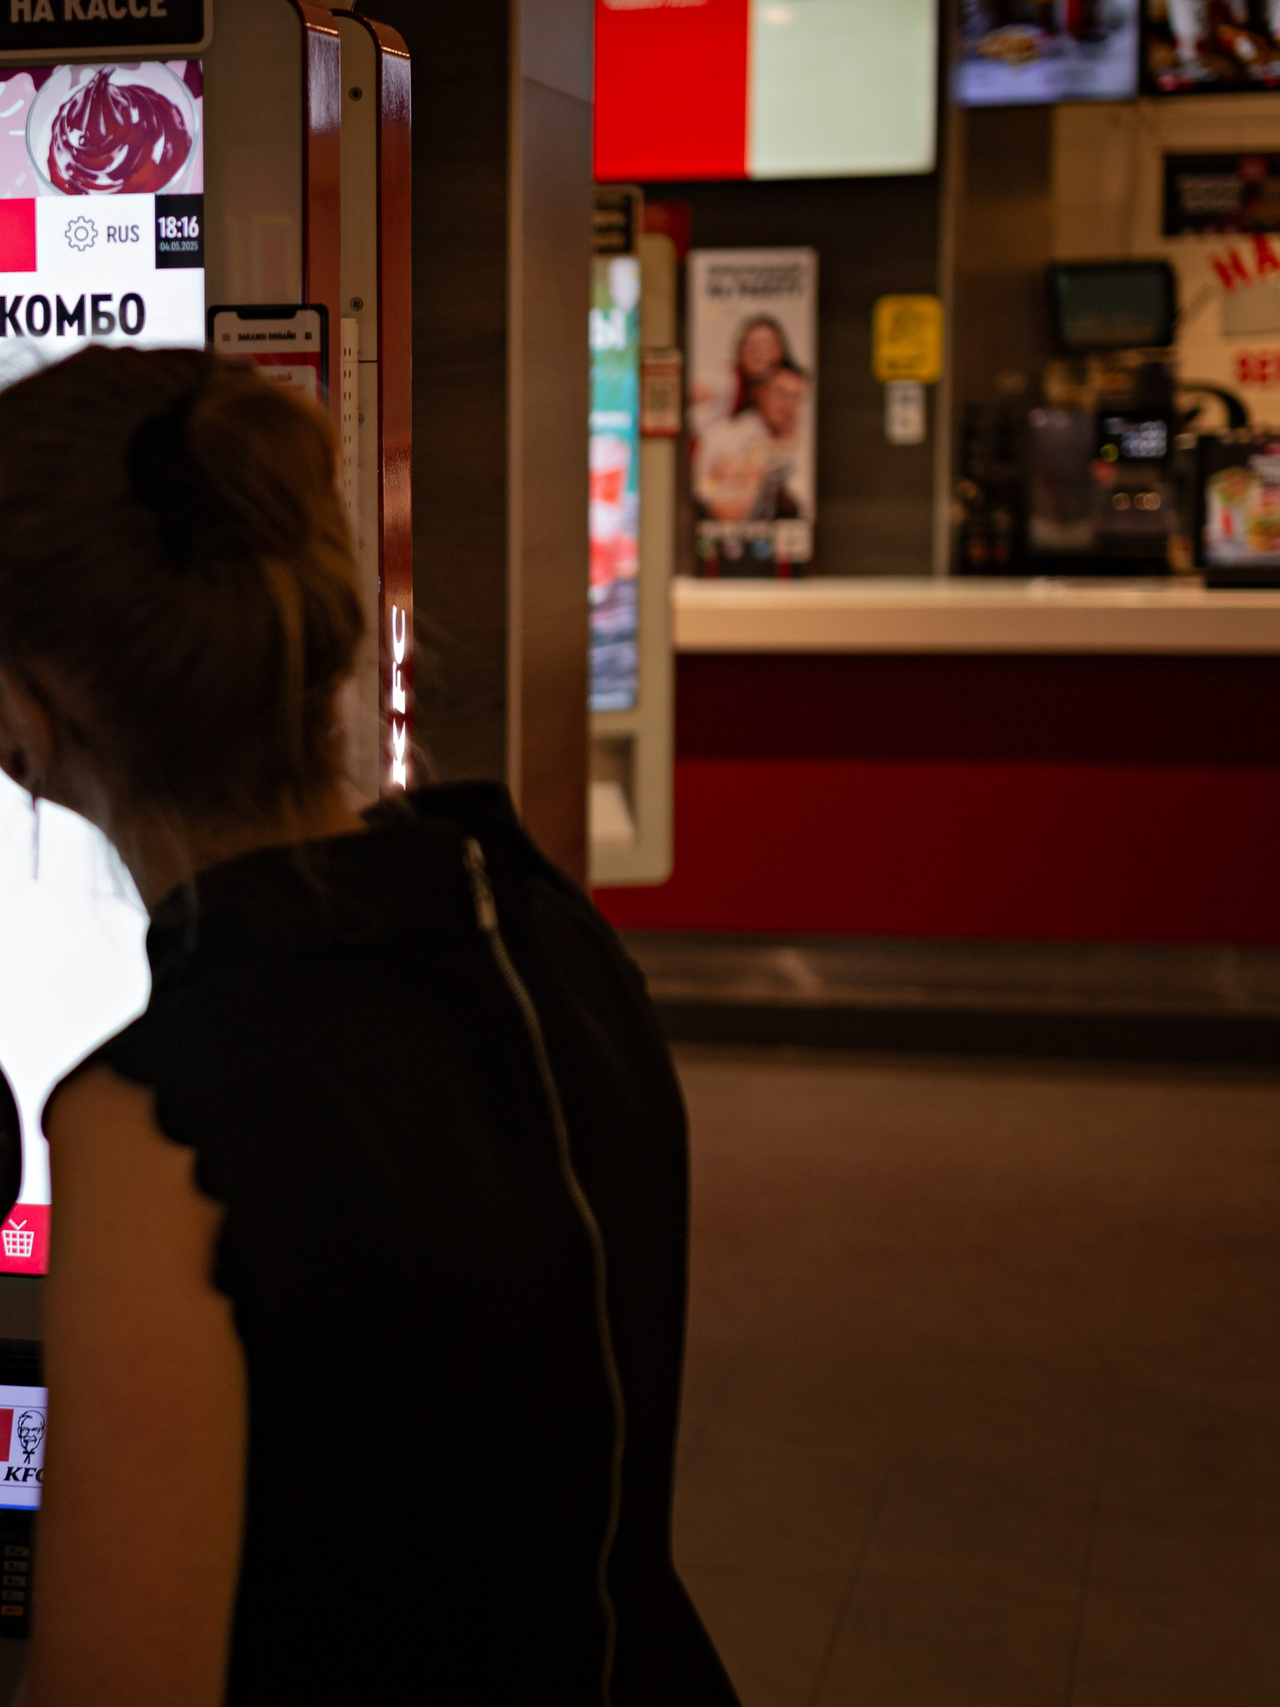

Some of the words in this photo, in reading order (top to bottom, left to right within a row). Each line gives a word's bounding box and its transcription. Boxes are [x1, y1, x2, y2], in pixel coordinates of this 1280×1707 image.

[106, 225, 141, 243] RUS
[157, 215, 200, 239] 18:16
[160, 240, 199, 252] 04.05.2025
